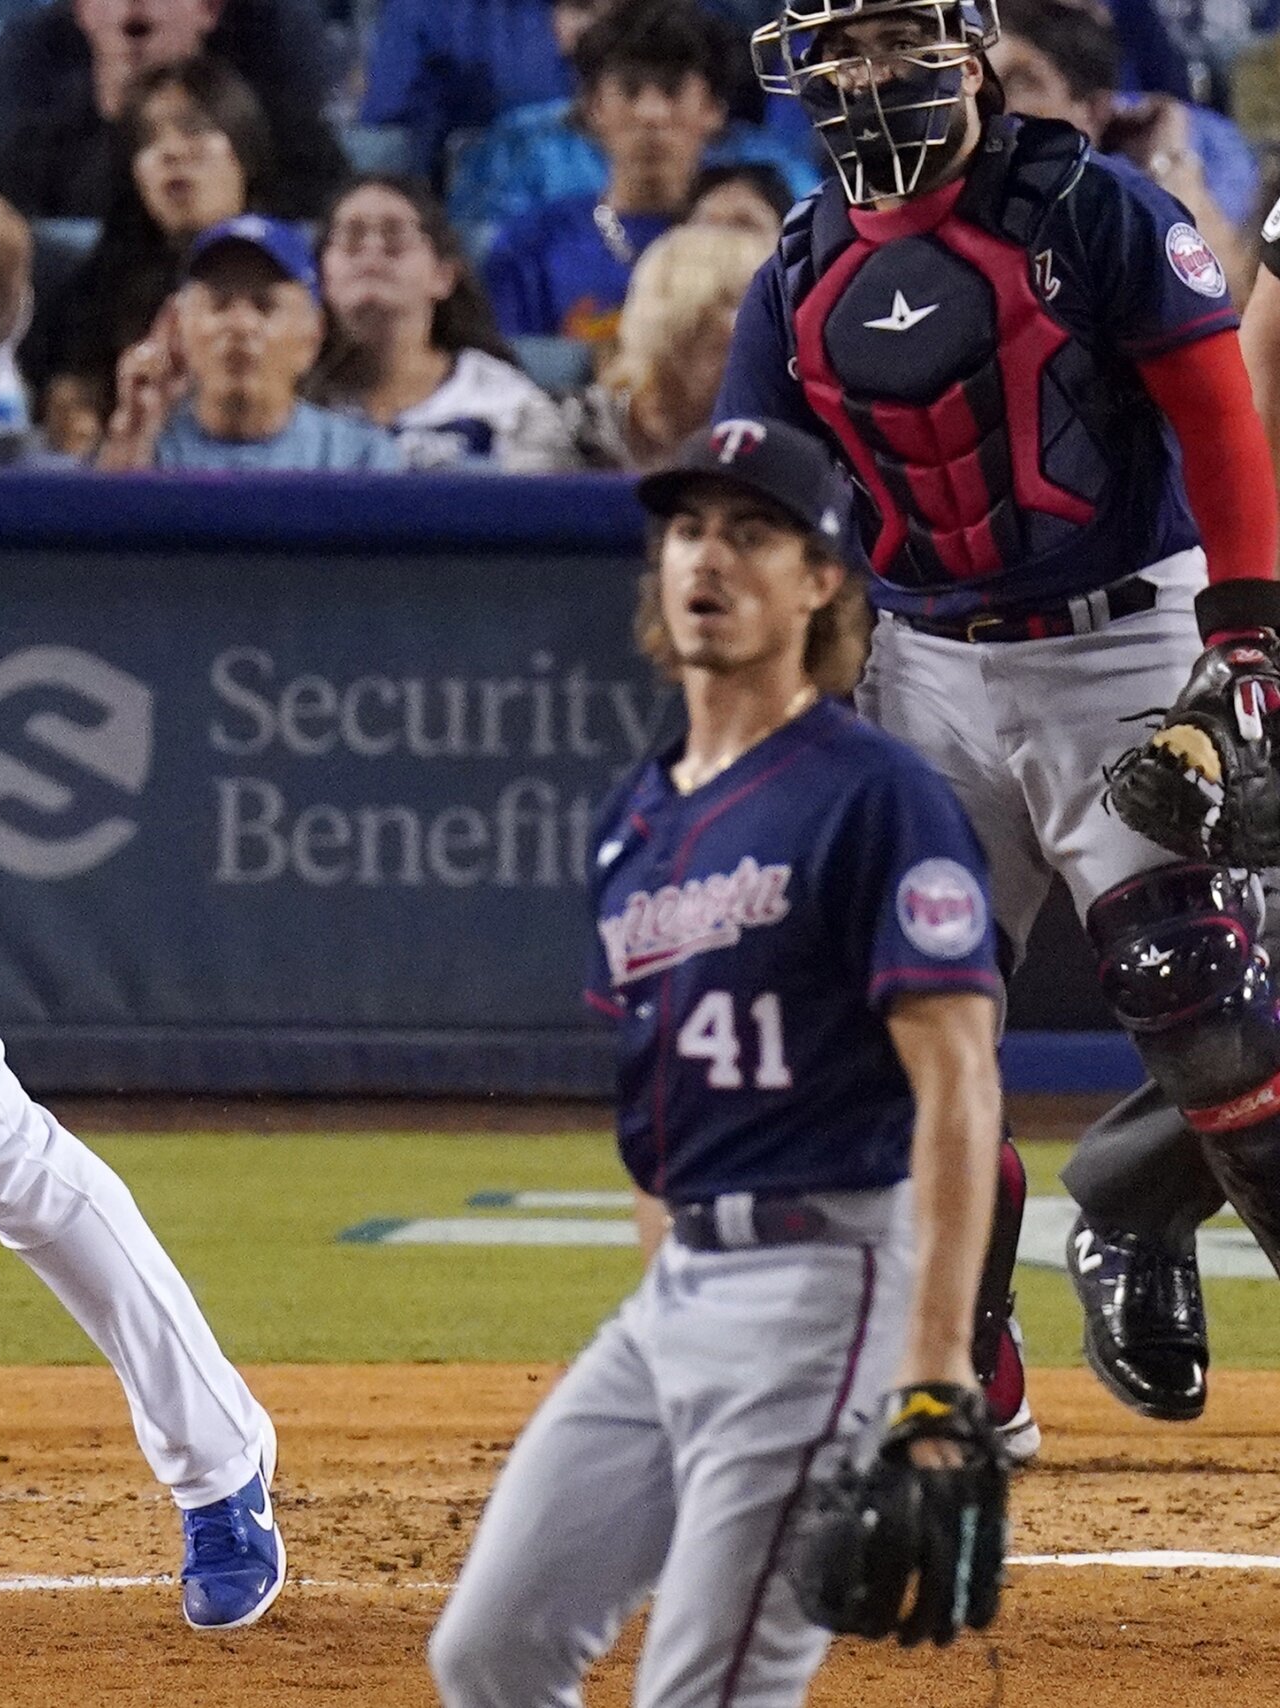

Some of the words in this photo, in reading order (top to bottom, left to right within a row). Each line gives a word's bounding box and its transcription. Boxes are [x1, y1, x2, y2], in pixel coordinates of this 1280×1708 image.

[211, 646, 672, 780] Security
[214, 775, 592, 887] Benefit
[676, 990, 793, 1089] 41
